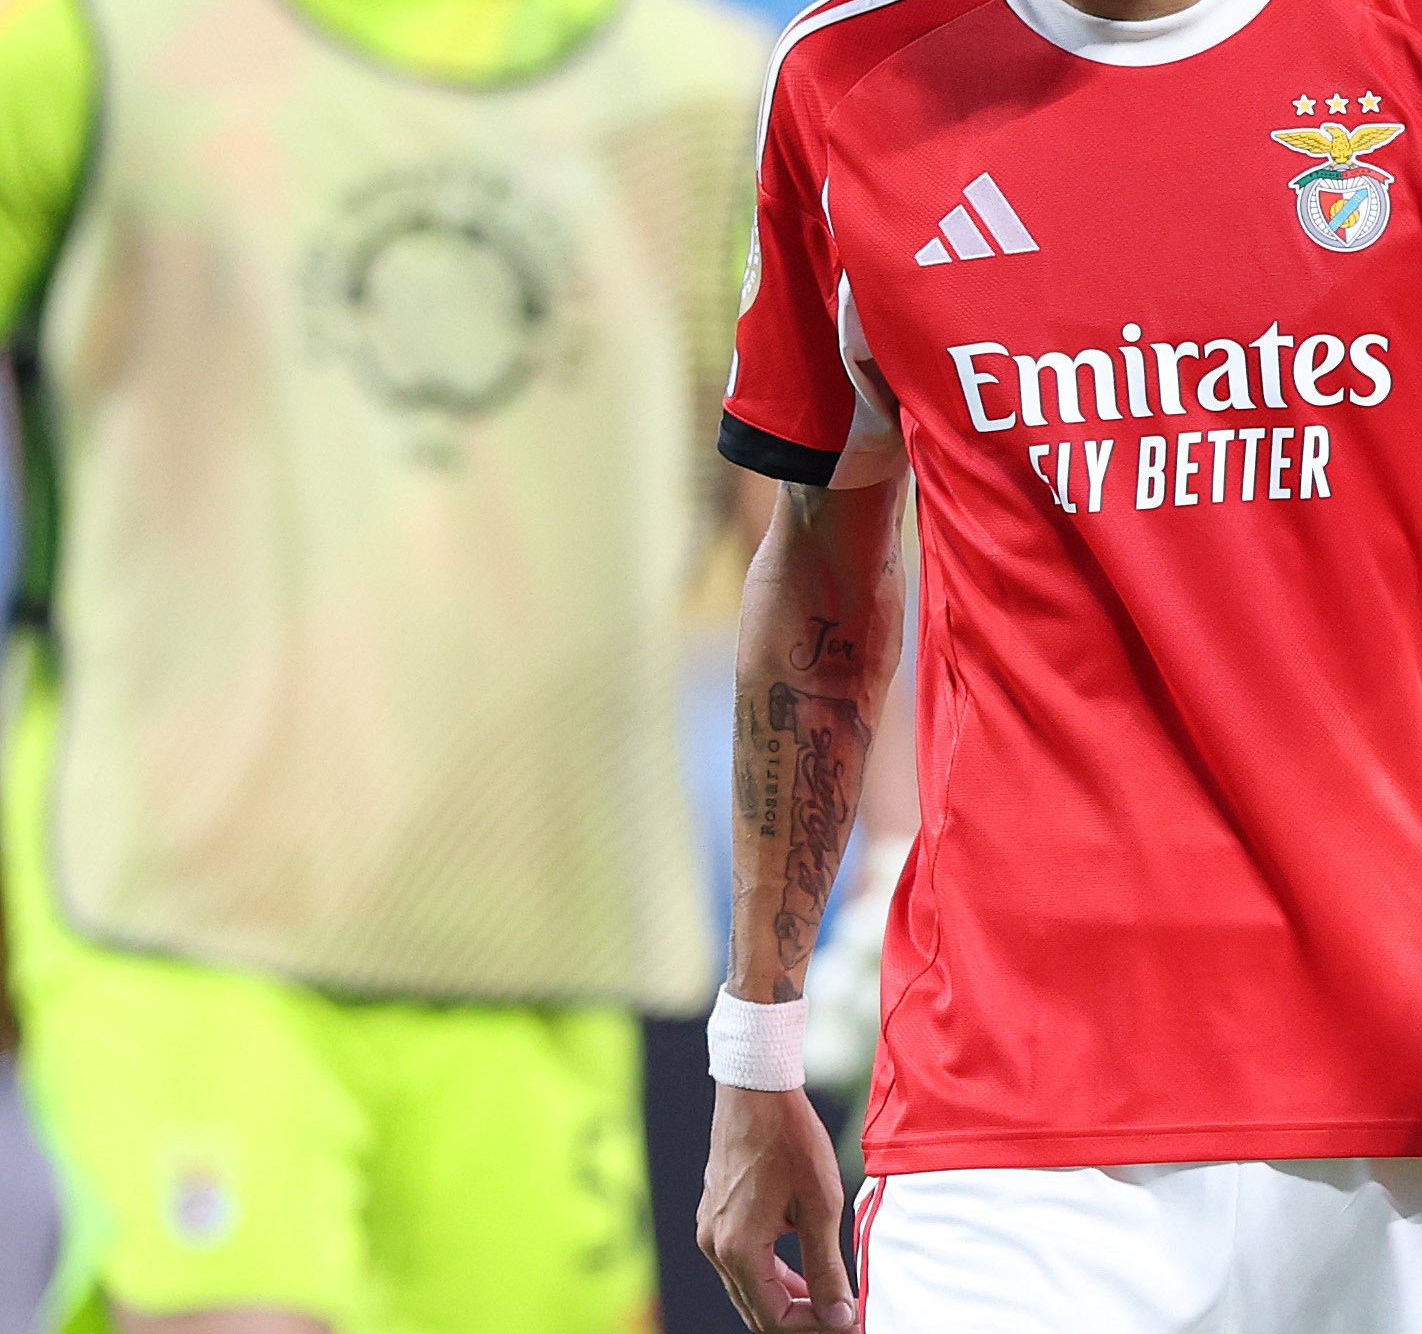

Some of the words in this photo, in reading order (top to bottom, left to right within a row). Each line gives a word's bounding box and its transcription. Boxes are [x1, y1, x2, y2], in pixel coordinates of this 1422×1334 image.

[946, 320, 1393, 434] Emirates
[1028, 438, 1115, 514] FLY
[1136, 424, 1332, 511] BETTER
